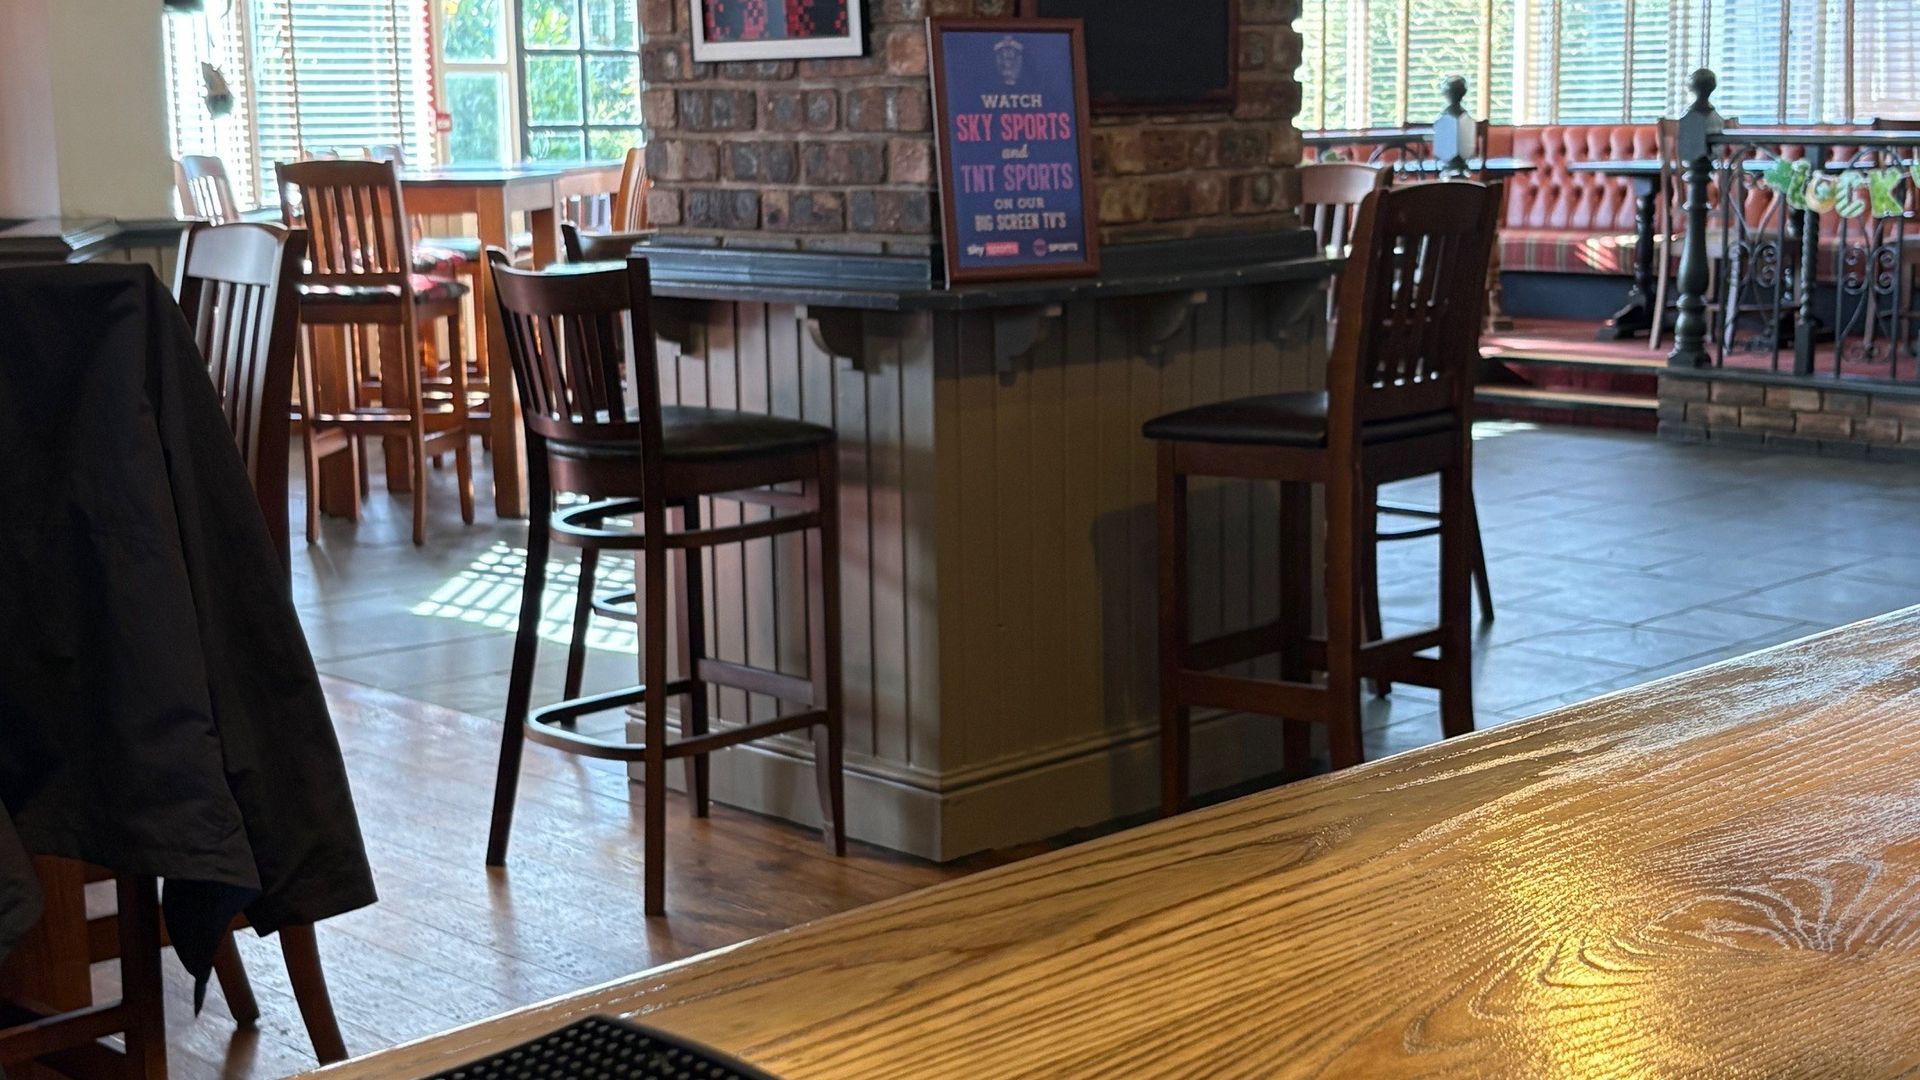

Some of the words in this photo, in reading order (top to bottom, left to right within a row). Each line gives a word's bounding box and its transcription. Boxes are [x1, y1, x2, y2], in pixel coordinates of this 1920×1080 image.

[981, 94, 1042, 109] WATCH
[956, 113, 992, 142] SKY
[1000, 112, 1071, 141] SPORTS
[1001, 143, 1029, 159] and
[961, 165, 996, 193] TNT
[1003, 162, 1074, 191] SPORTS
[994, 198, 1013, 210] ON
[1017, 197, 1045, 209] OUR
[996, 213, 1040, 230] SCREEN
